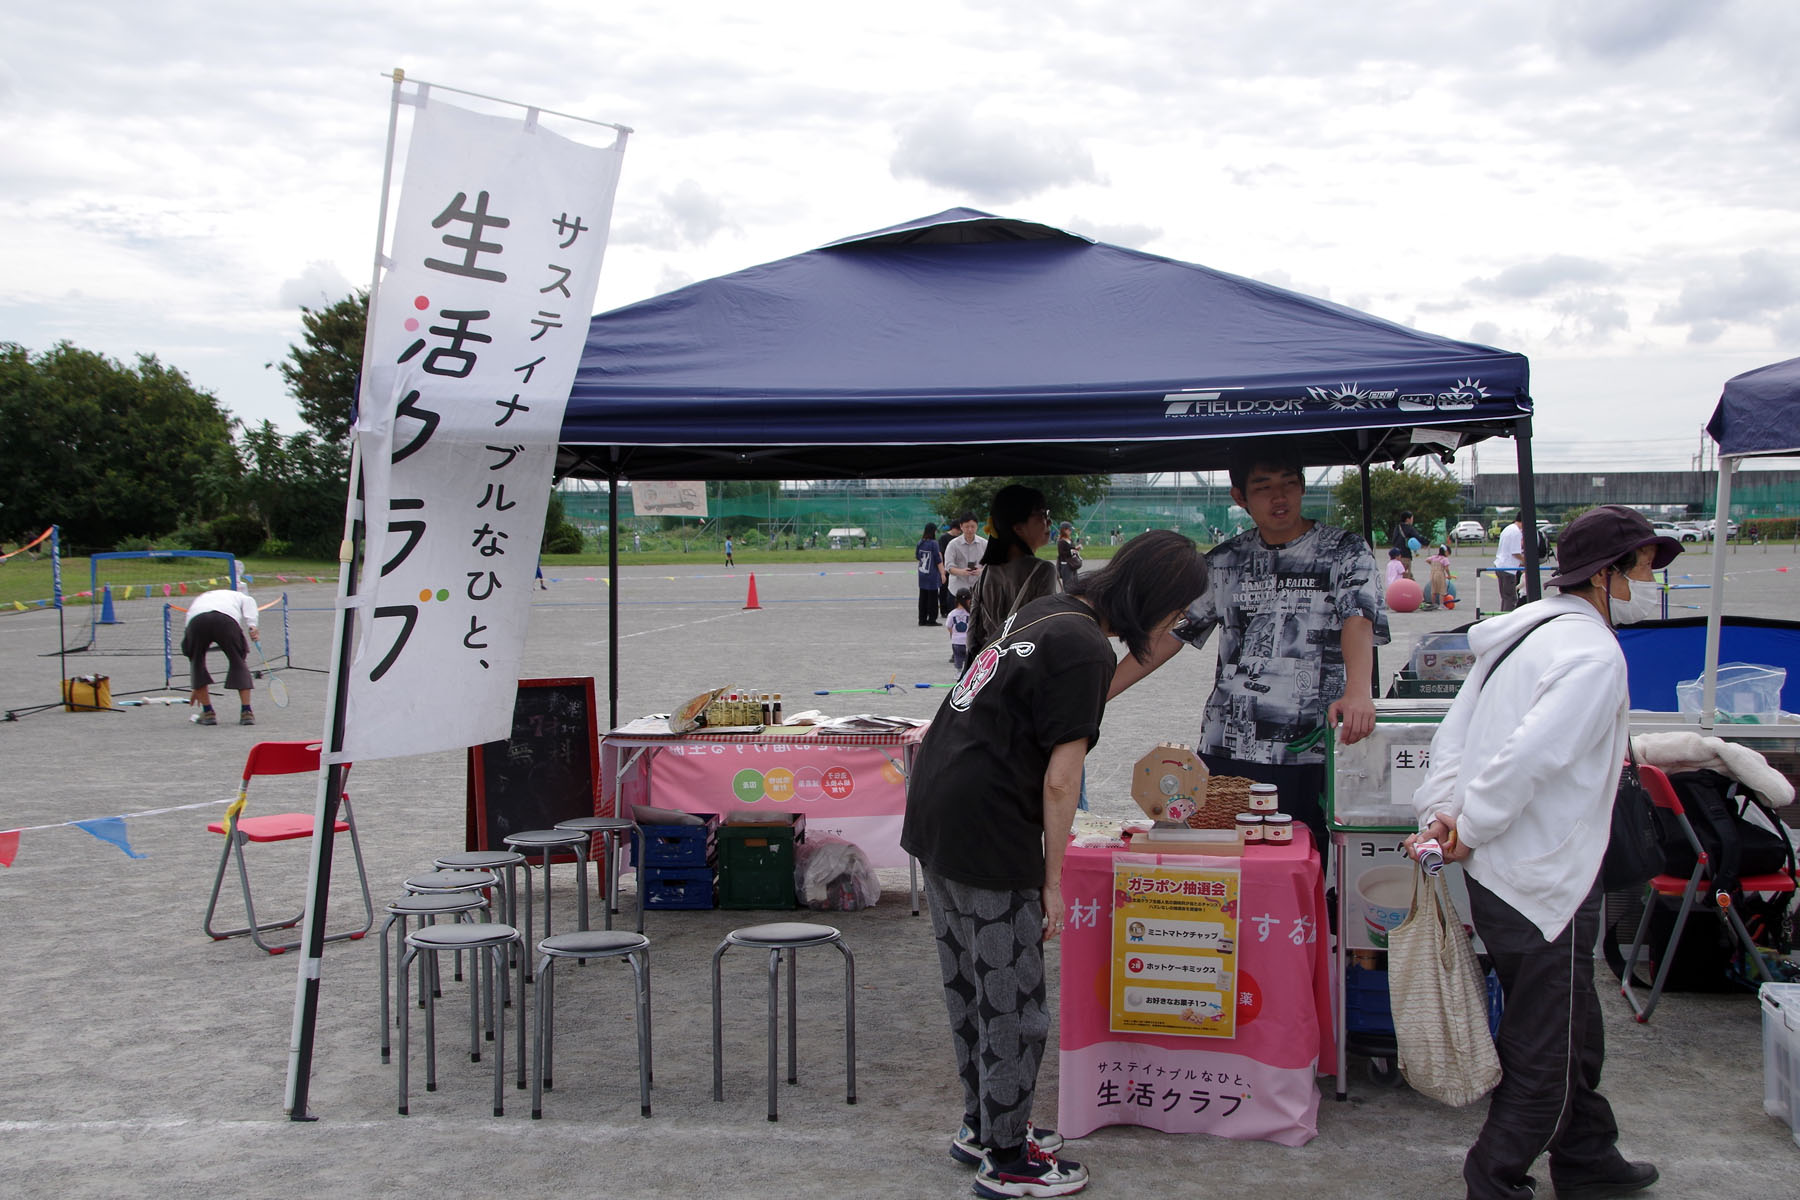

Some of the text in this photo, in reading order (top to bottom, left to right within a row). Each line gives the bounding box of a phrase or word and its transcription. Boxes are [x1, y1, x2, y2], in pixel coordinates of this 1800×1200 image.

[1195, 399, 1304, 414] FIELDOOR
[463, 212, 589, 669] サステイナブルなひと、
[1128, 878, 1226, 896] ガラポン抽選会
[1148, 928, 1218, 940] ミニトマトケチャップ
[1146, 963, 1217, 974] ホットケーキミックス
[1145, 996, 1207, 1008] お好きなお菓子1つ
[1097, 1061, 1251, 1088] サステイナブルなひと、
[1096, 1079, 1252, 1117] 生活クラブ
